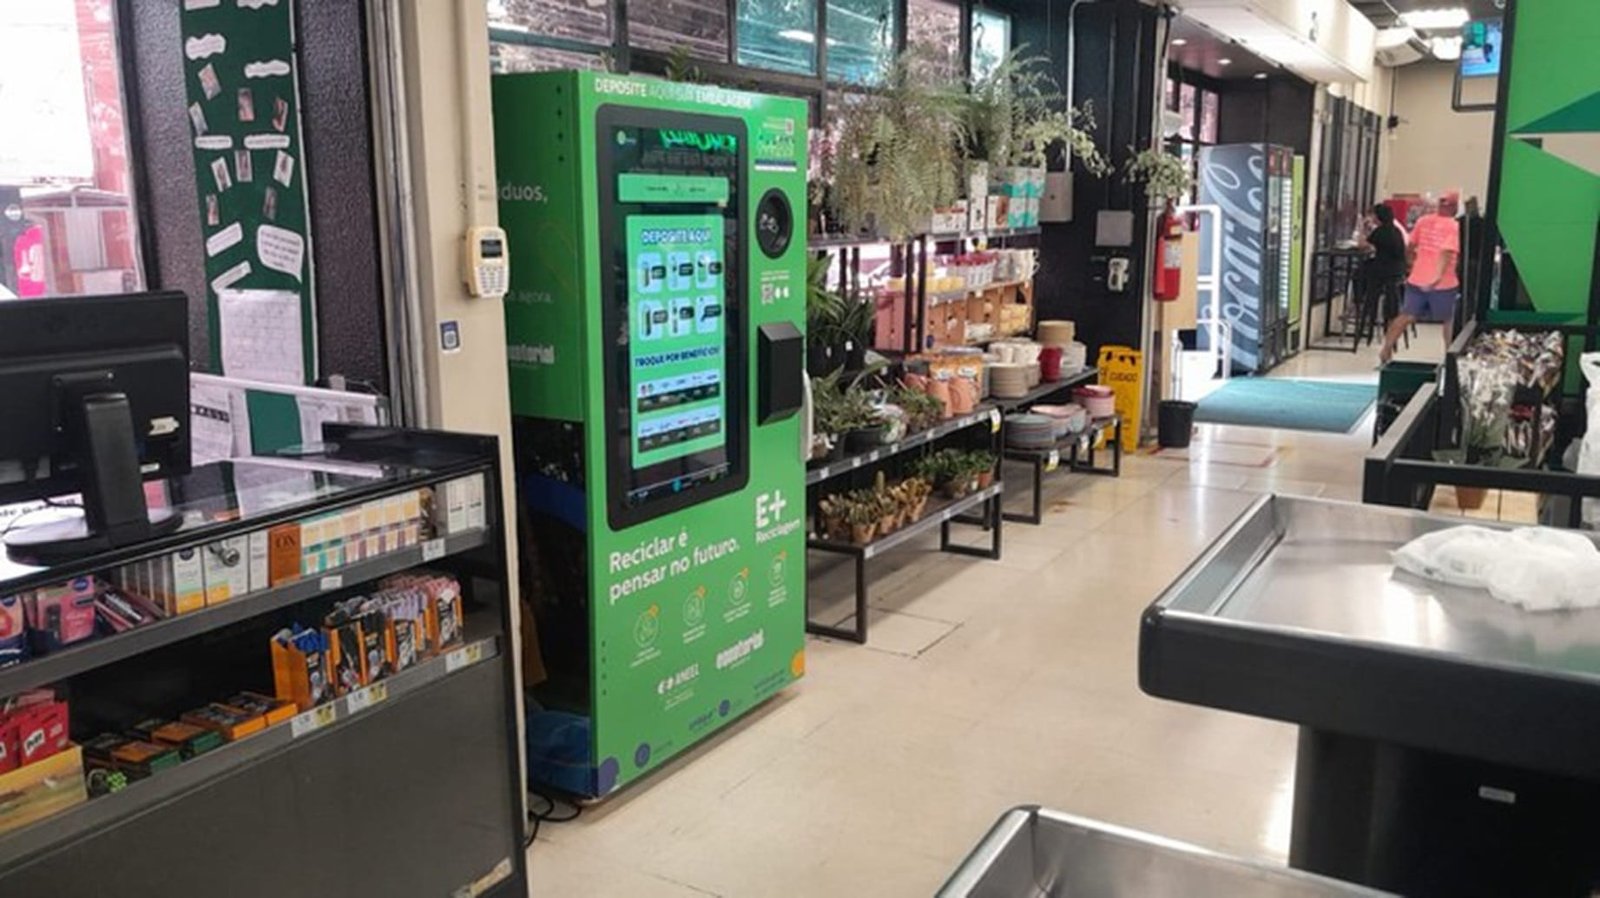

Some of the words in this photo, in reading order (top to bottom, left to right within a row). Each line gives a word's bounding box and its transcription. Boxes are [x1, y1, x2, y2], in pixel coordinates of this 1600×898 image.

[594, 78, 647, 97] DEPOSITE
[608, 562, 667, 606] pensar
[669, 556, 690, 577] no
[692, 536, 741, 567] futuro.
[609, 535, 675, 574] Reciclar
